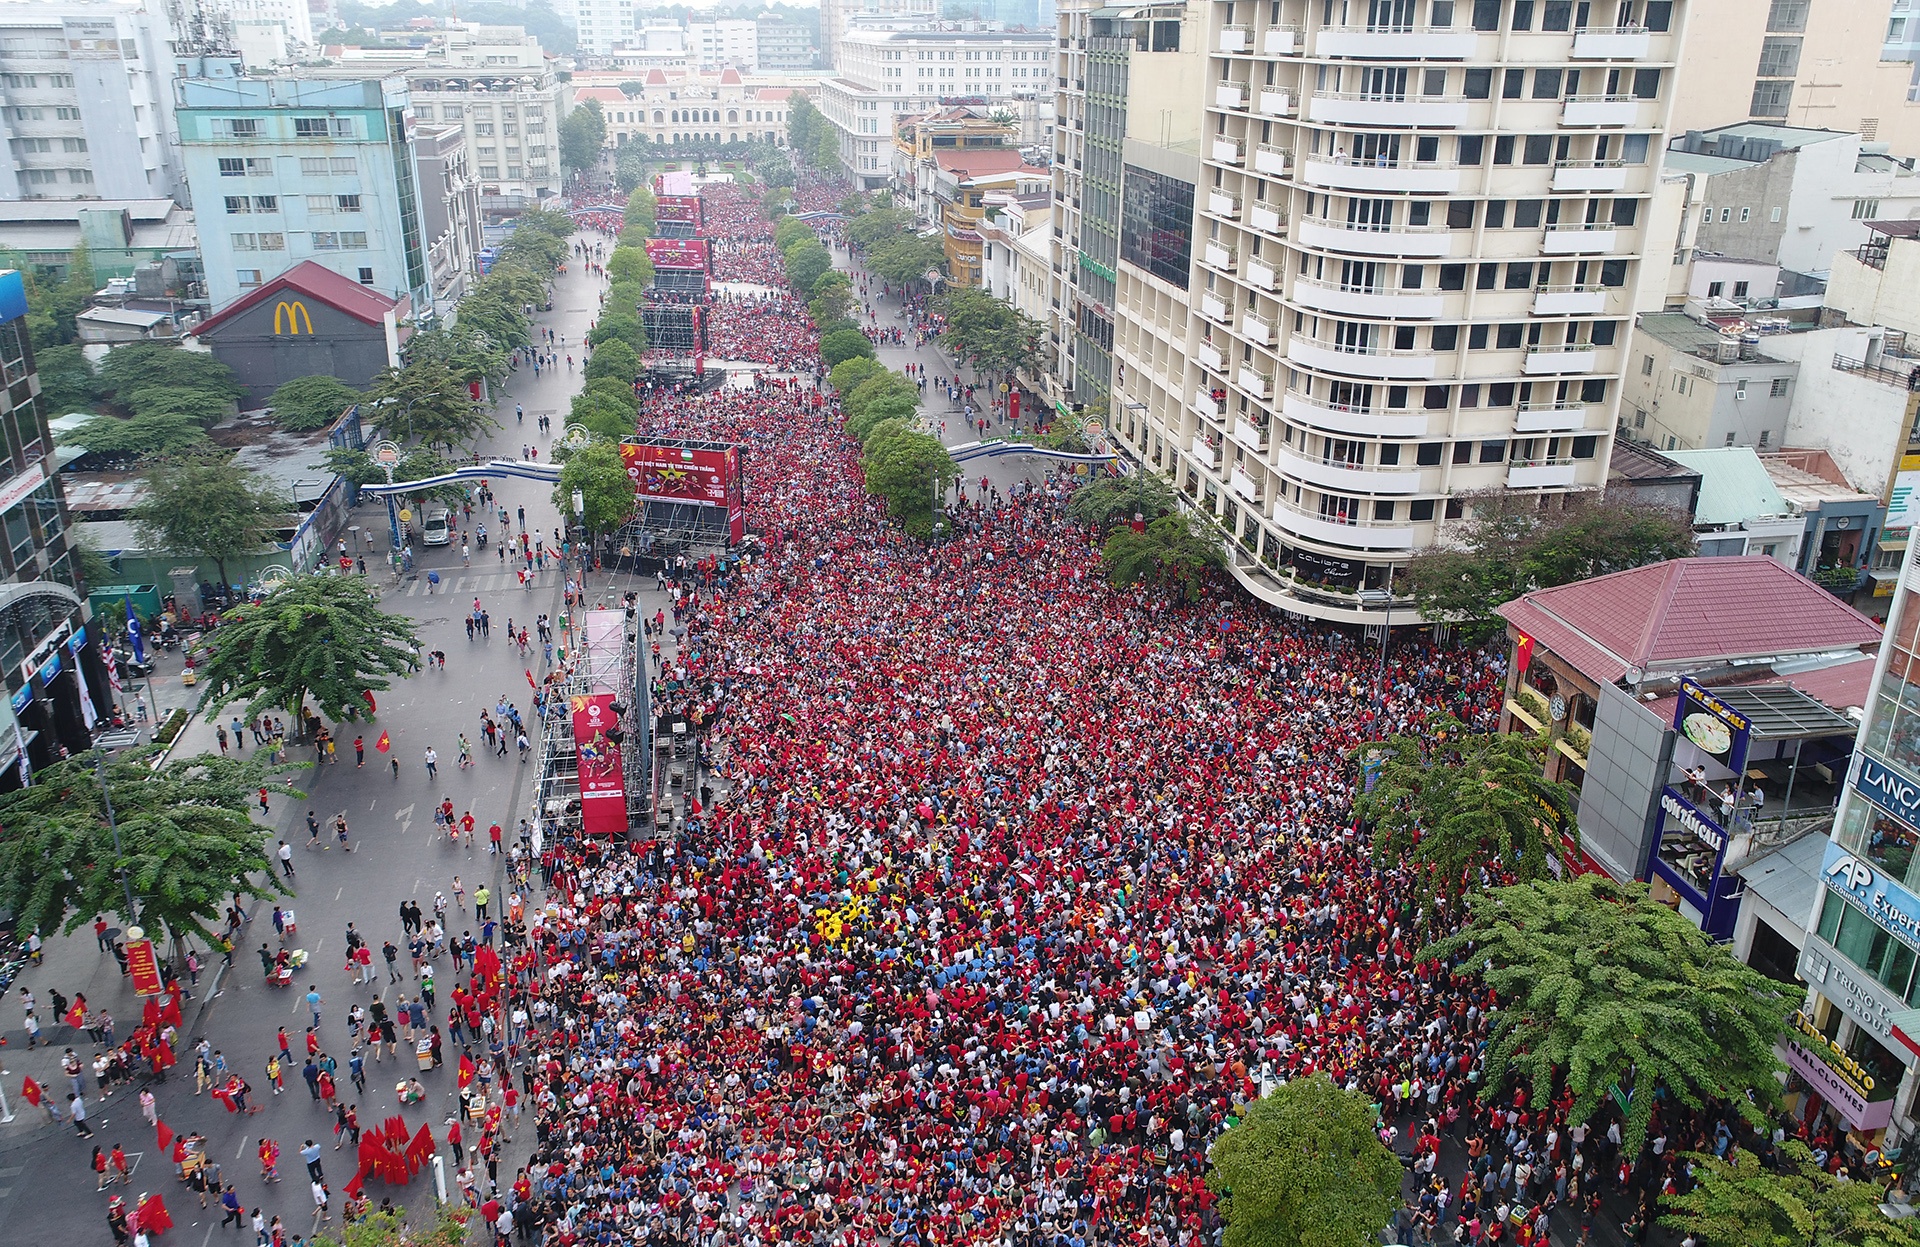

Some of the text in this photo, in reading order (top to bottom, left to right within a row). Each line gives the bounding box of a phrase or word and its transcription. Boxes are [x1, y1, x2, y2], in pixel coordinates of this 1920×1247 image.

[1698, 824, 1722, 851] CALI
[1825, 876, 1868, 913] Accounting
[1832, 965, 1875, 1008] TRUNG
[1844, 996, 1891, 1039] GROUP
[1830, 1040, 1876, 1091] Bistro
